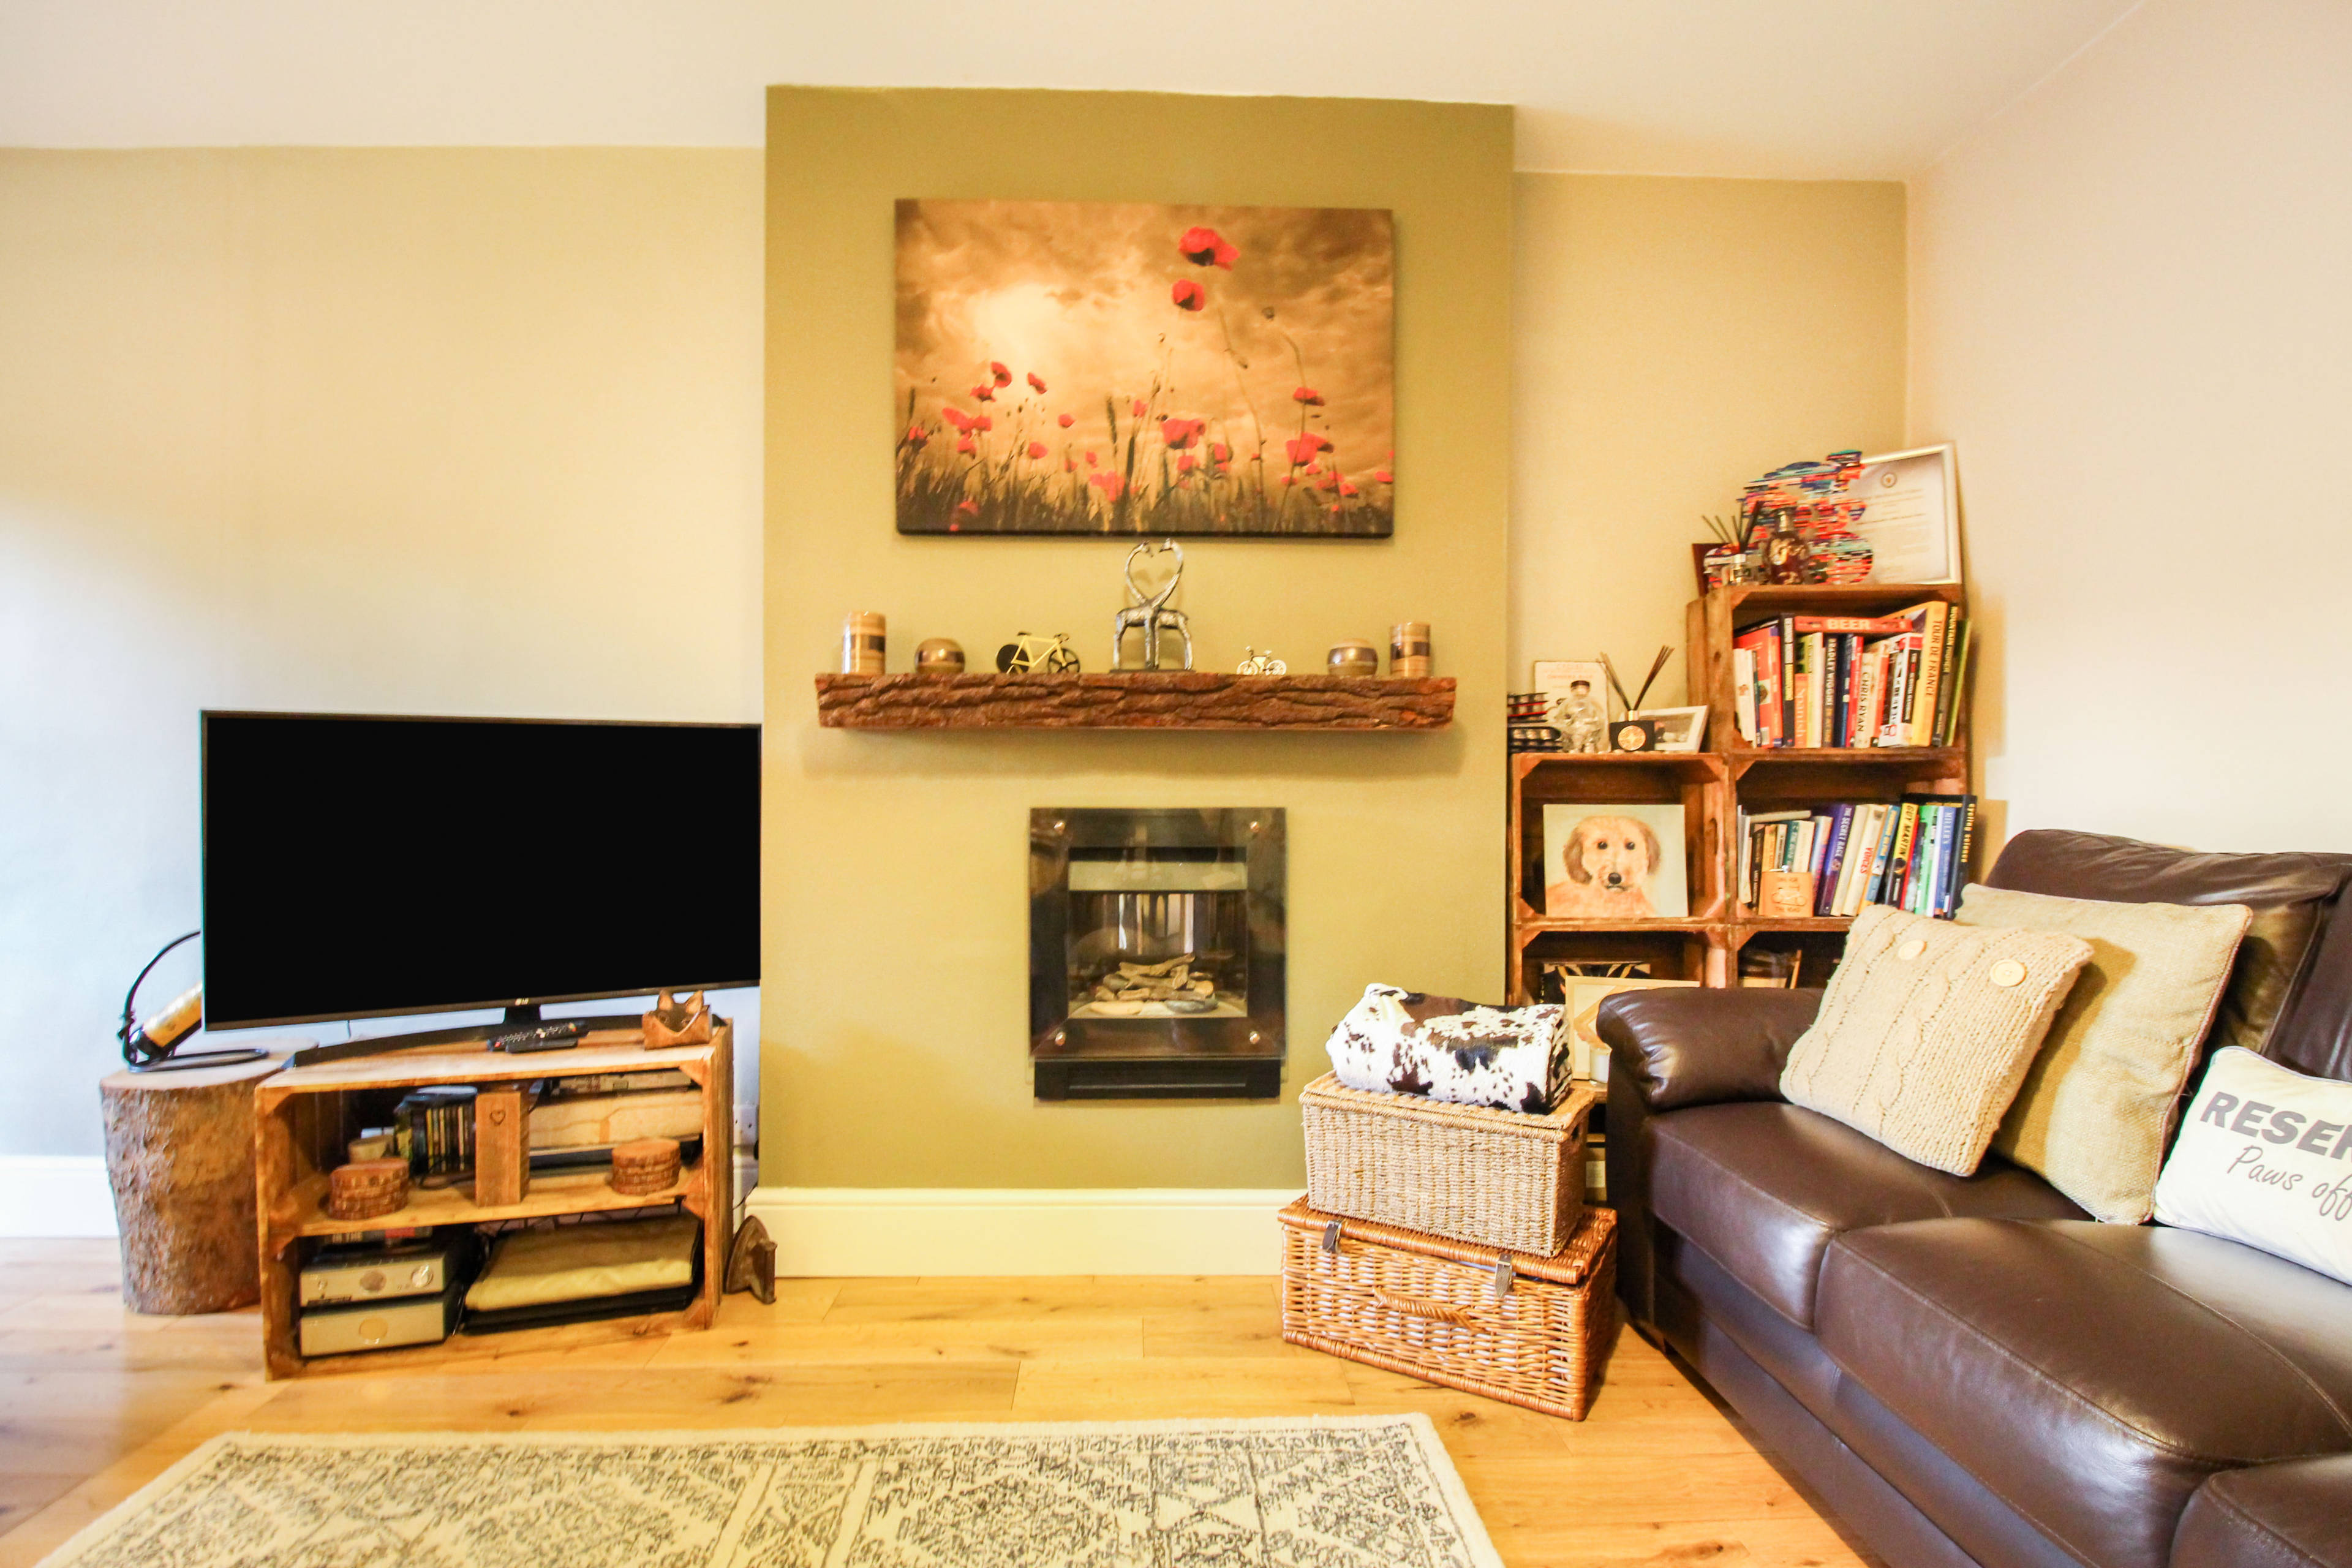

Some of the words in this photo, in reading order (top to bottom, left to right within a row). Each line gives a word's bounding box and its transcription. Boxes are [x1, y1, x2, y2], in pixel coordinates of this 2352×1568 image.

[1826, 619, 1871, 630] BEER
[1931, 619, 1943, 644] TOUR
[1826, 638, 1837, 671] BRADLEY
[1929, 646, 1940, 657] DE
[1860, 671, 1869, 702] CHRIS
[1925, 659, 1939, 697] FRANCE
[1856, 705, 1867, 733] RYAN
[1905, 805, 1915, 822] GUY
[1964, 804, 1976, 831] cycling
[1838, 817, 1850, 840] SECRET
[1899, 824, 1912, 857] MARTIN
[1834, 842, 1844, 858] RACE
[1860, 847, 1874, 874] VOICES
[2227, 1145, 2304, 1191] Paws
